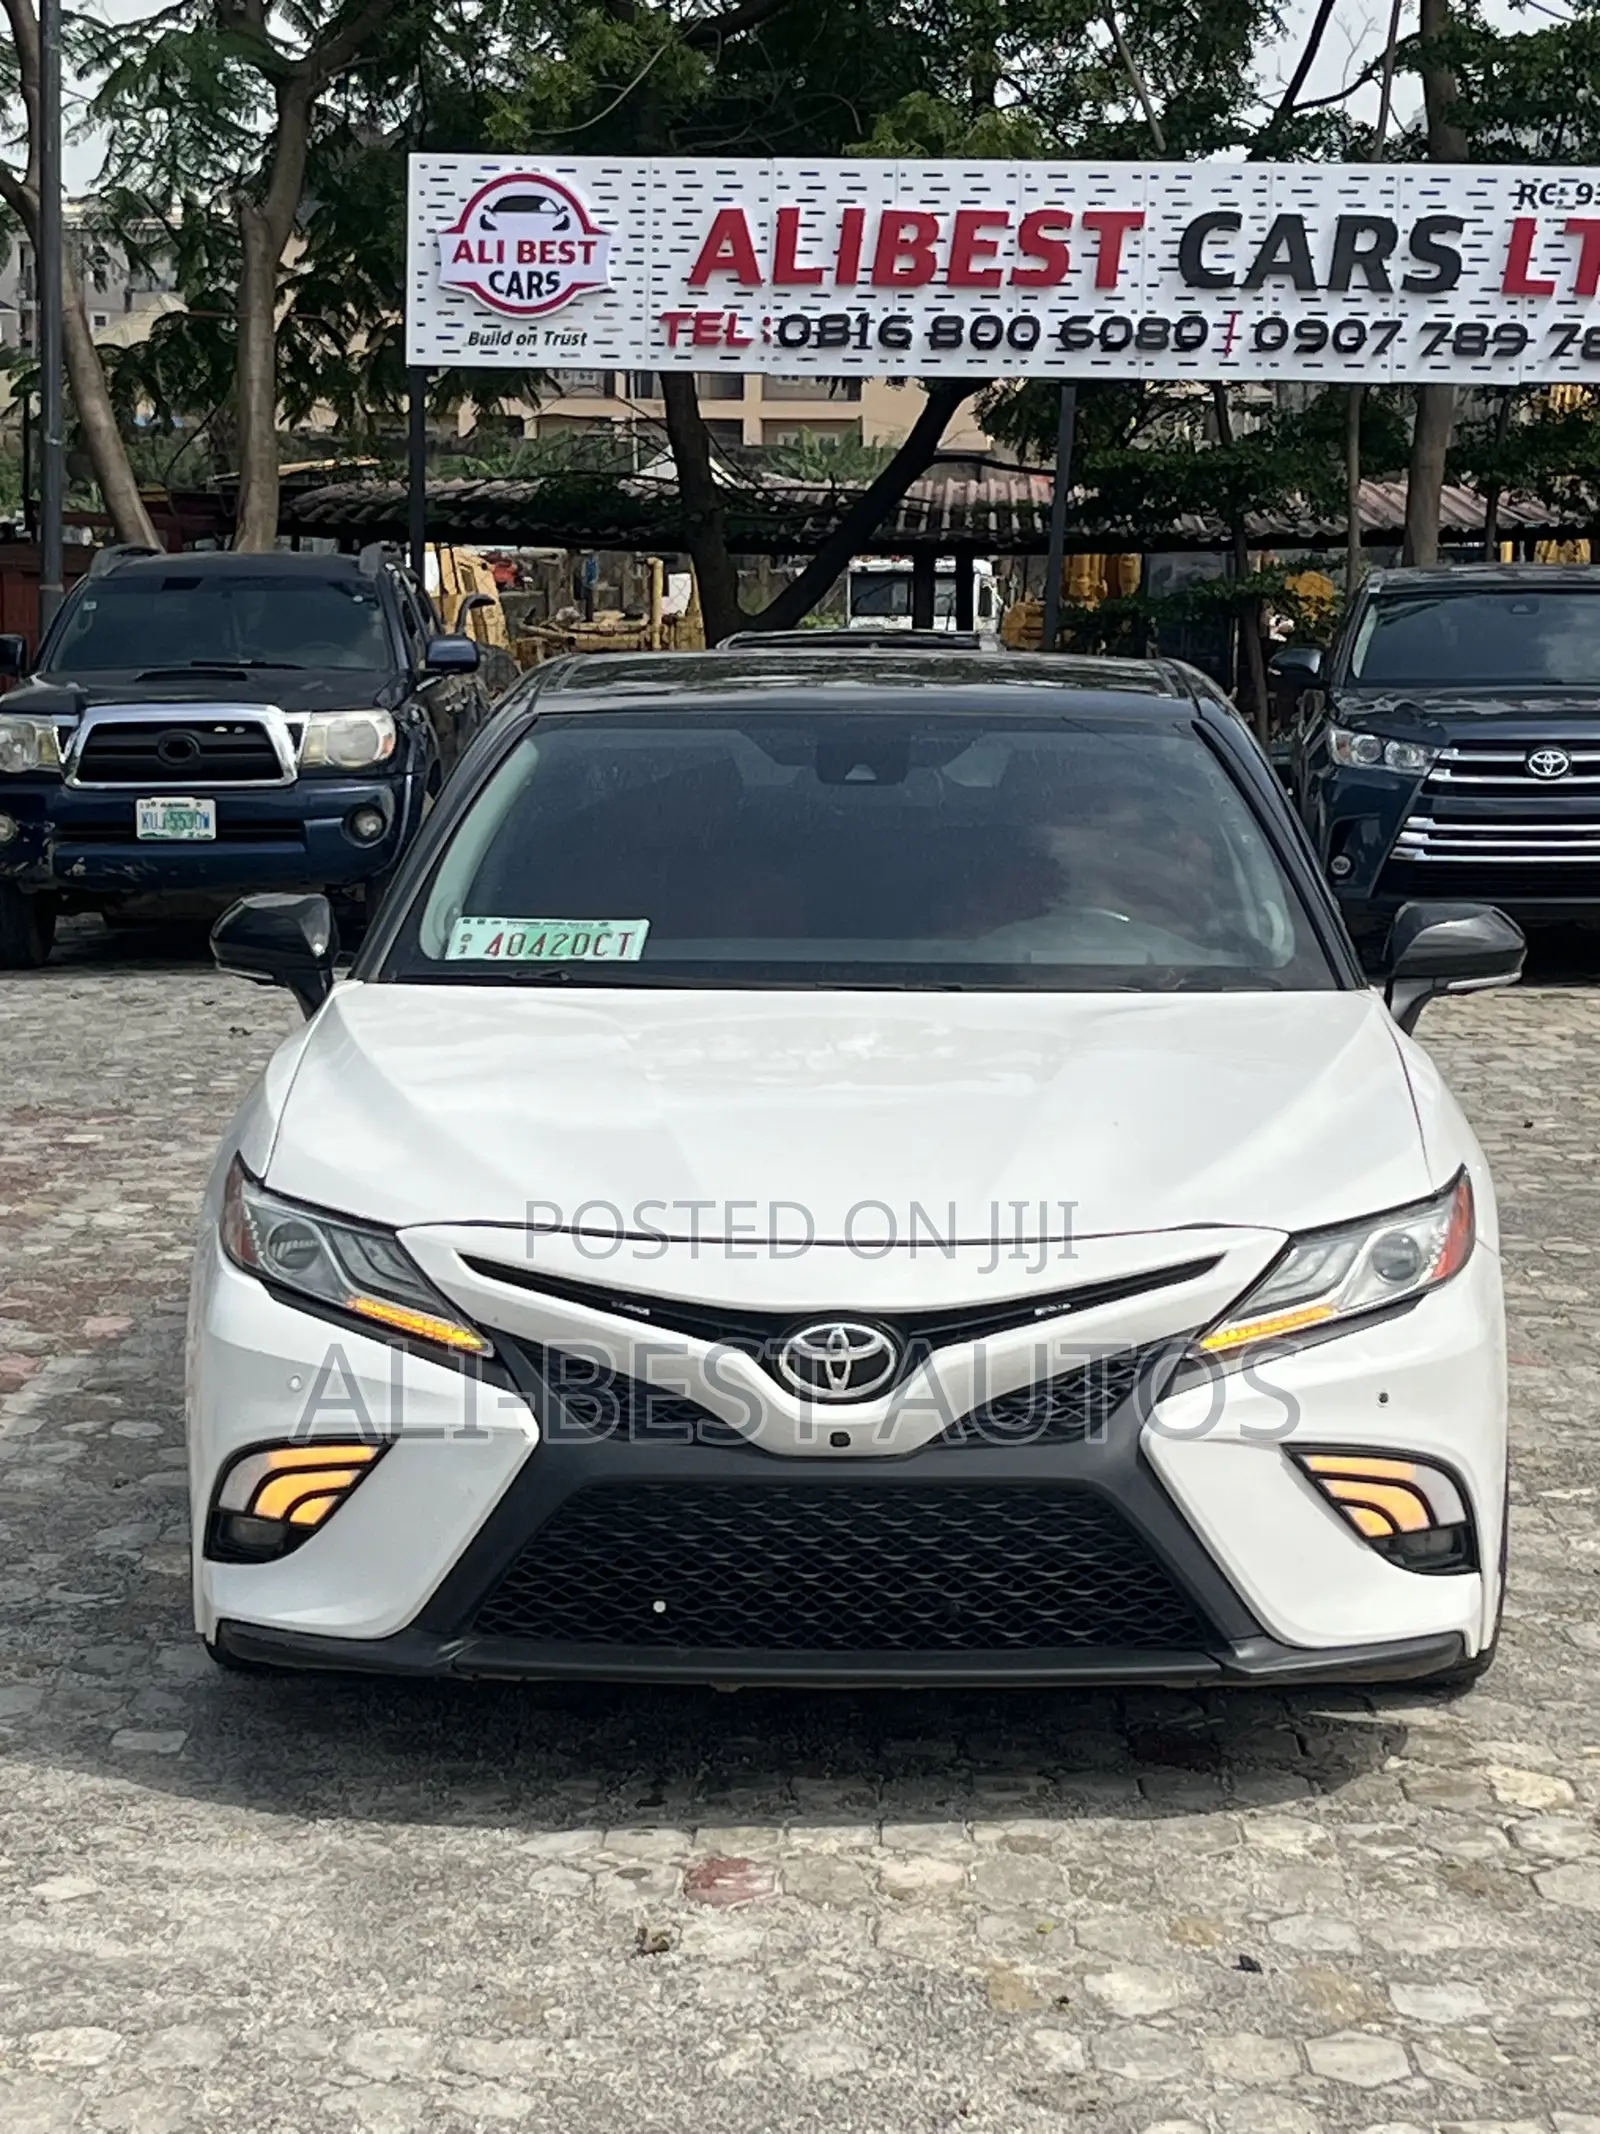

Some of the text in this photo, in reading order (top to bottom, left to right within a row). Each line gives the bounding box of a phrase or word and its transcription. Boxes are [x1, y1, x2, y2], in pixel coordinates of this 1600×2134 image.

[452, 240, 597, 265] ALI BEST
[687, 208, 1145, 289] ALIBEST
[1178, 211, 1465, 294] CARS
[488, 271, 560, 300] CARS
[468, 331, 588, 346] Build on Trust
[777, 313, 913, 350] 0816
[929, 315, 1041, 351] 800
[1059, 315, 1208, 352] 6080
[1253, 317, 1402, 355] 0907
[1419, 322, 1529, 357] 789
